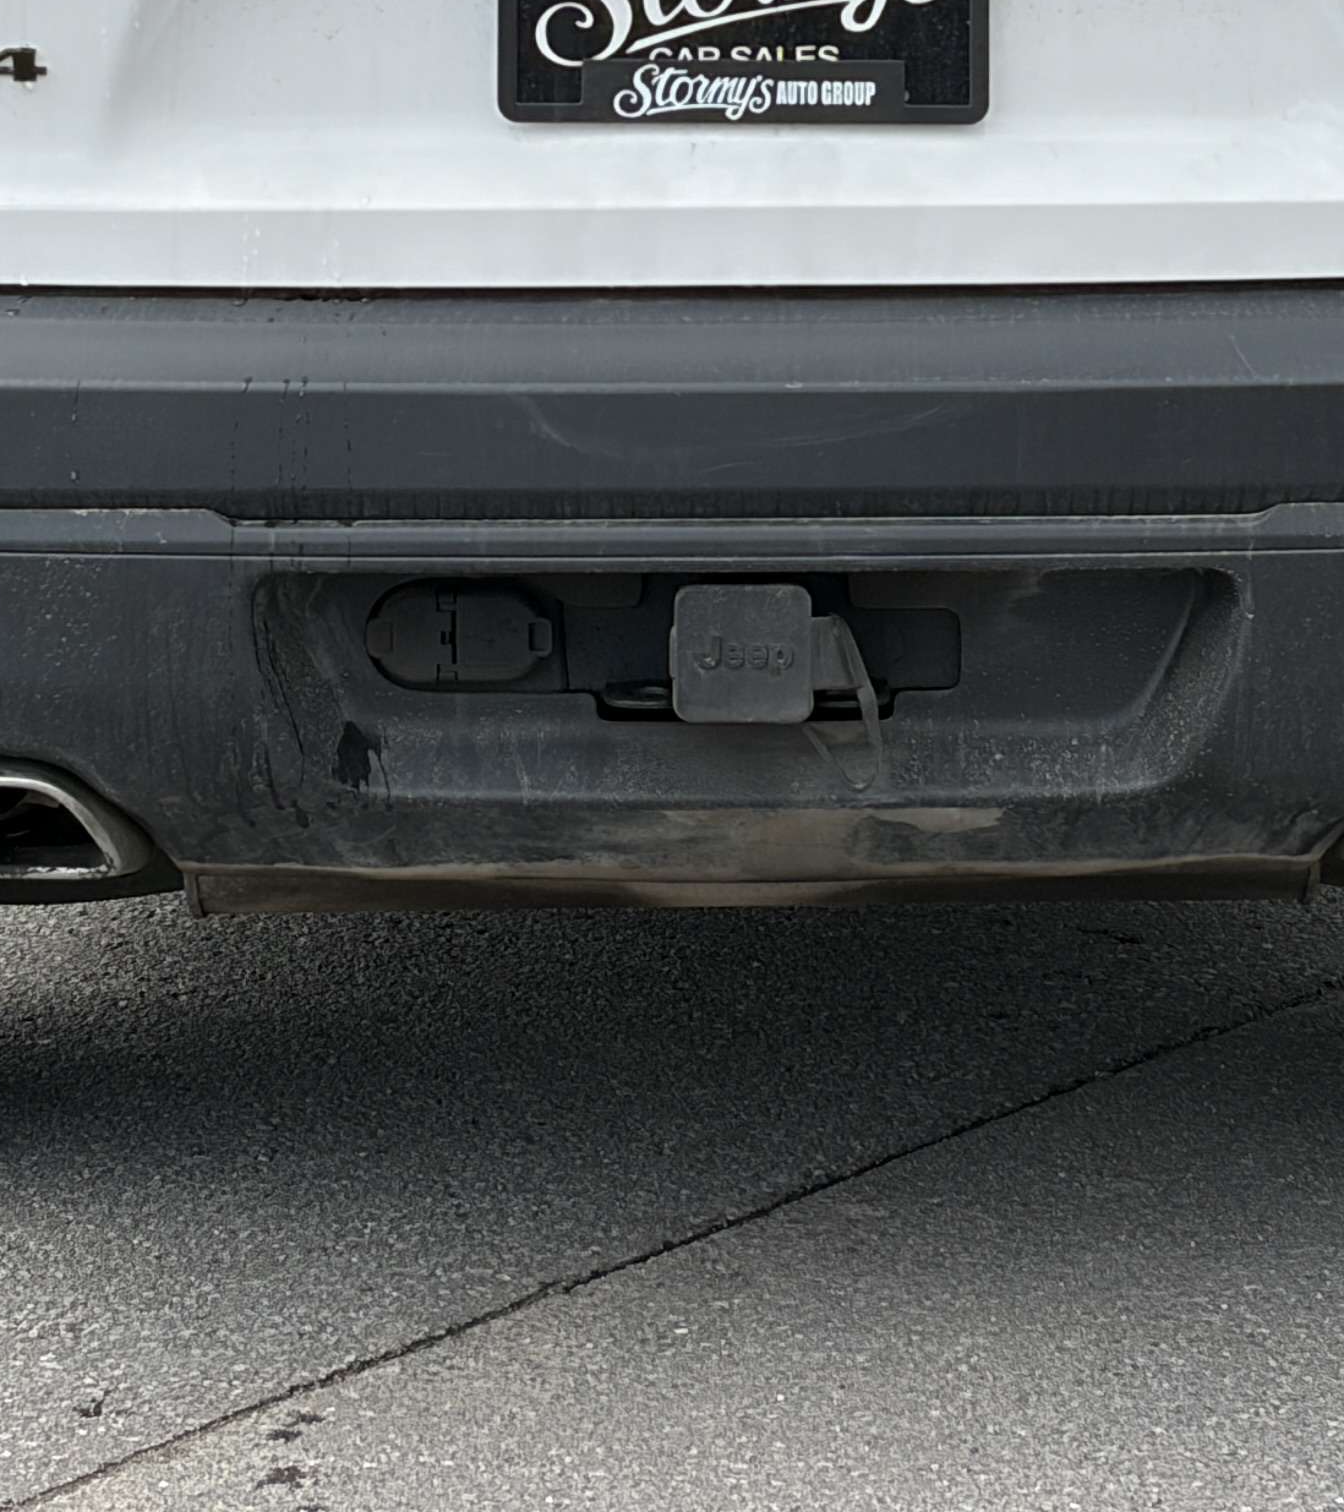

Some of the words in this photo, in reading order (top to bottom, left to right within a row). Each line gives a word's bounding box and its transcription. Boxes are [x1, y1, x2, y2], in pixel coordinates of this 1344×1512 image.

[613, 63, 774, 121] Stormy's
[776, 80, 818, 105] AUTO
[821, 80, 877, 106] GROUP
[692, 635, 794, 678] Jeep
